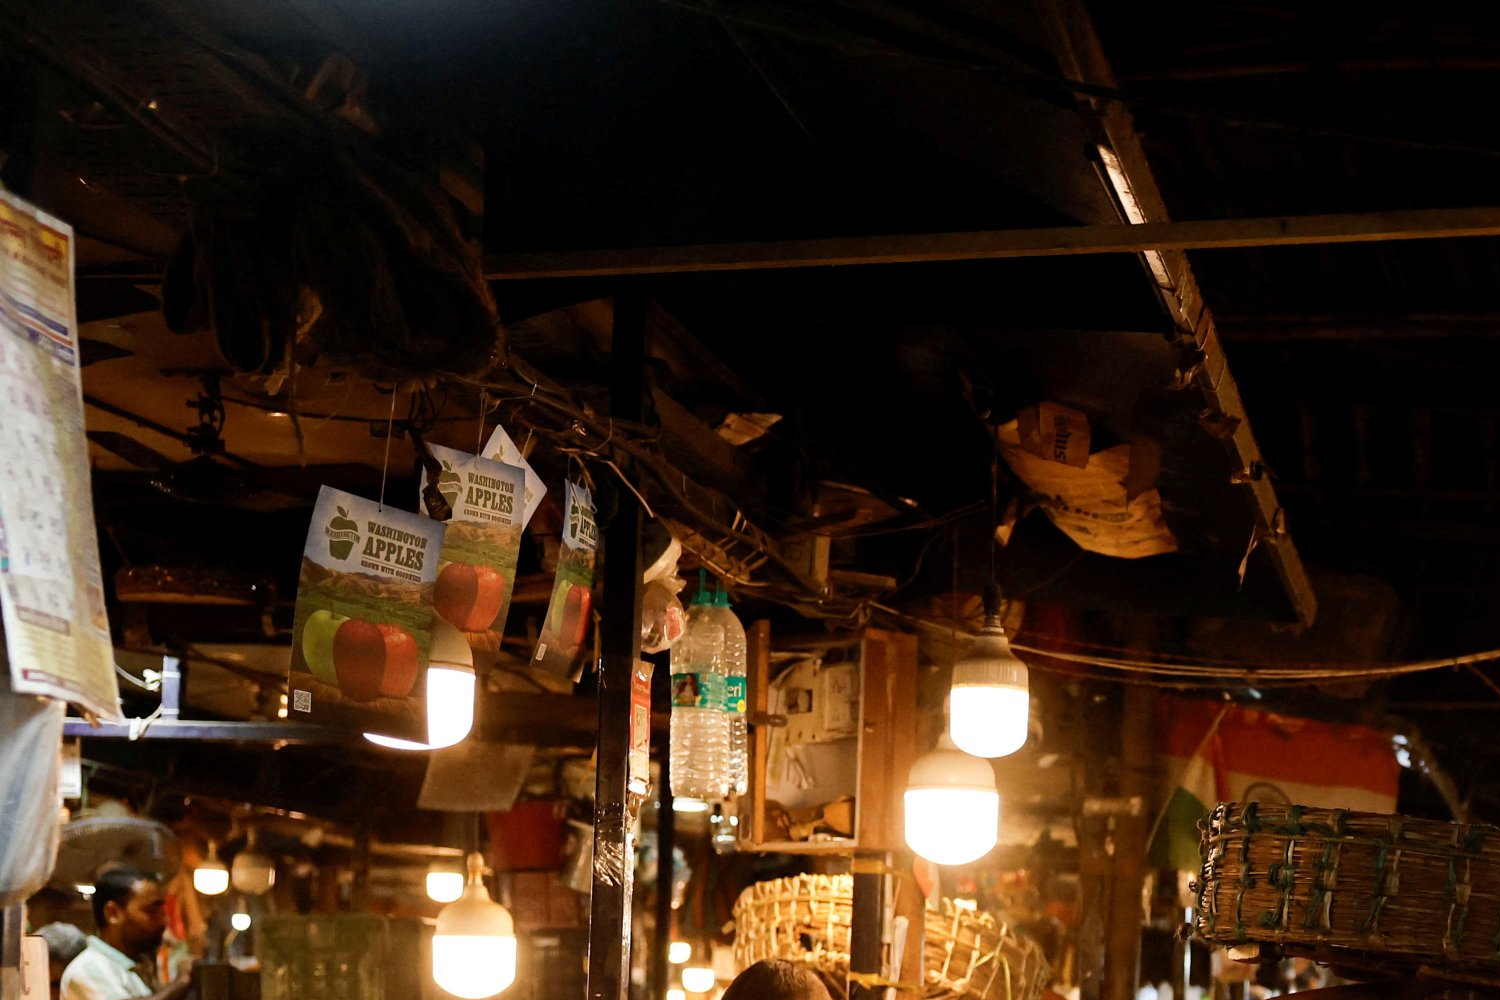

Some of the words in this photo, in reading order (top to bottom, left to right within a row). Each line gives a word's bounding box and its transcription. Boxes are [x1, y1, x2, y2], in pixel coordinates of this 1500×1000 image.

[468, 472, 515, 494] WASHINGTON
[464, 486, 514, 514] APPLES
[367, 521, 428, 550] WASHINGTON
[362, 536, 424, 571] APPLES
